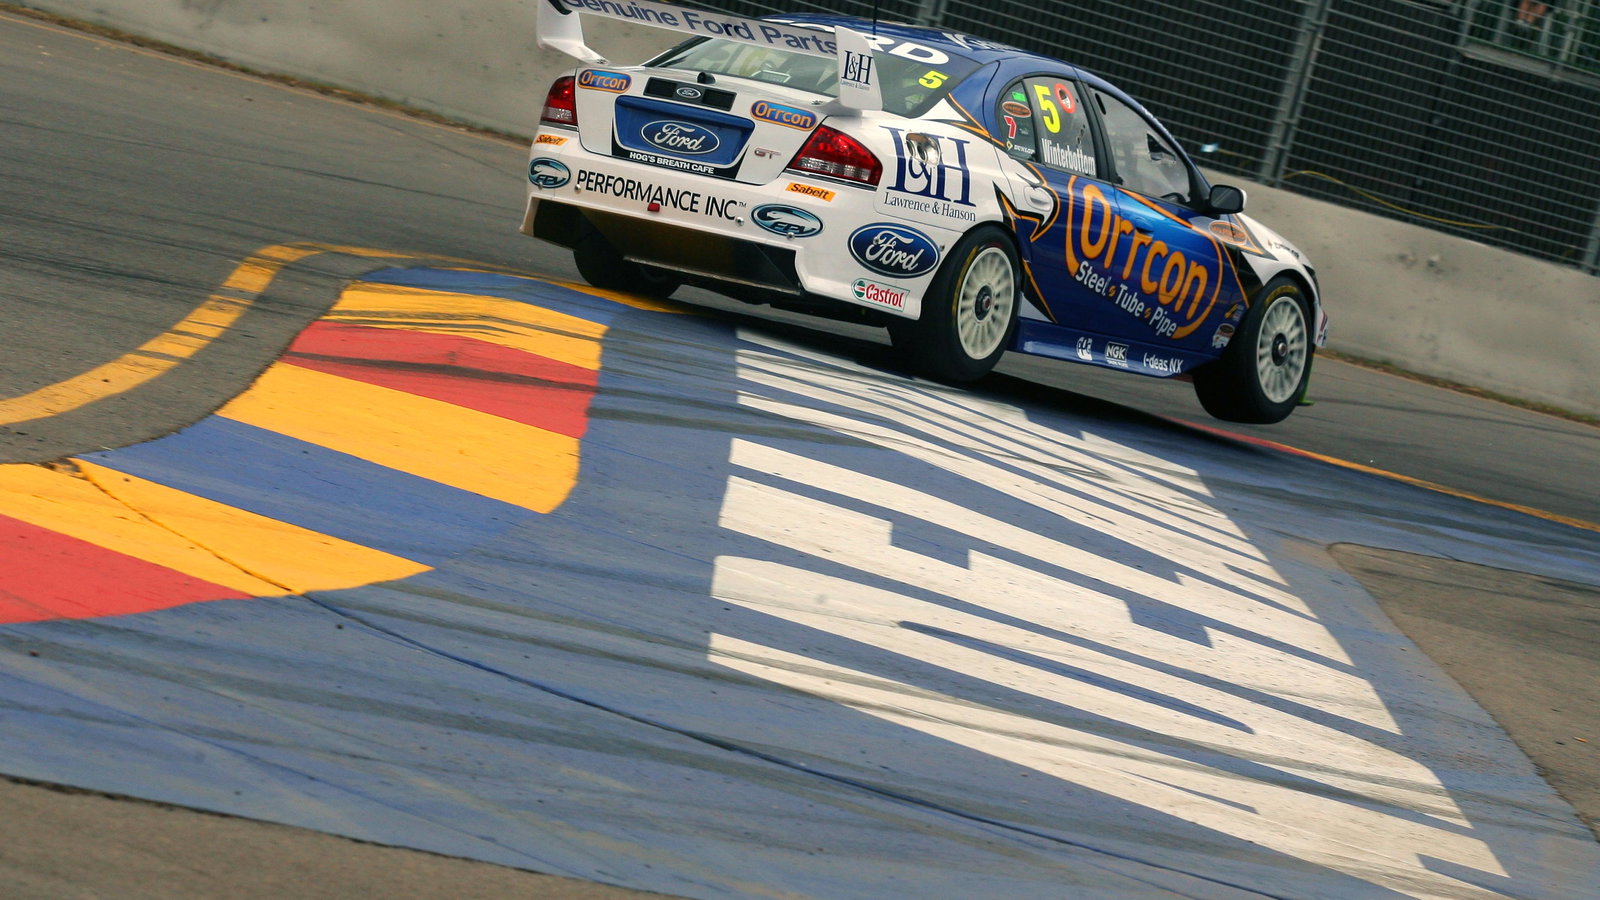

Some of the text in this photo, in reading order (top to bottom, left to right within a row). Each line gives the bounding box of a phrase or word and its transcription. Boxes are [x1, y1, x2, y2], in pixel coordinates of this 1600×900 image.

[682, 11, 756, 41] Ford
[759, 26, 837, 56] Parts
[581, 71, 627, 90] Orrcon
[841, 50, 873, 86] L&H
[918, 70, 949, 89] 5
[755, 102, 812, 129] Orrcon
[1033, 84, 1061, 134] 5
[654, 123, 706, 151] Ford
[629, 151, 715, 174] HOG'S BREATH CAFE
[754, 148, 782, 159] GT
[1041, 138, 1096, 176] Winterbottom
[577, 169, 701, 213] PERFORMANCE
[790, 183, 830, 199] Sabelt
[884, 192, 976, 222] Lawrence & Hanson
[865, 230, 920, 271] Ford
[1080, 184, 1208, 320] Orrcon
[865, 283, 903, 308] Castrol
[1075, 260, 1112, 296] Steel
[1115, 283, 1145, 317] Tube
[1149, 306, 1177, 337] Pipe
[1106, 345, 1125, 360] NGK
[1169, 358, 1184, 374] NX
